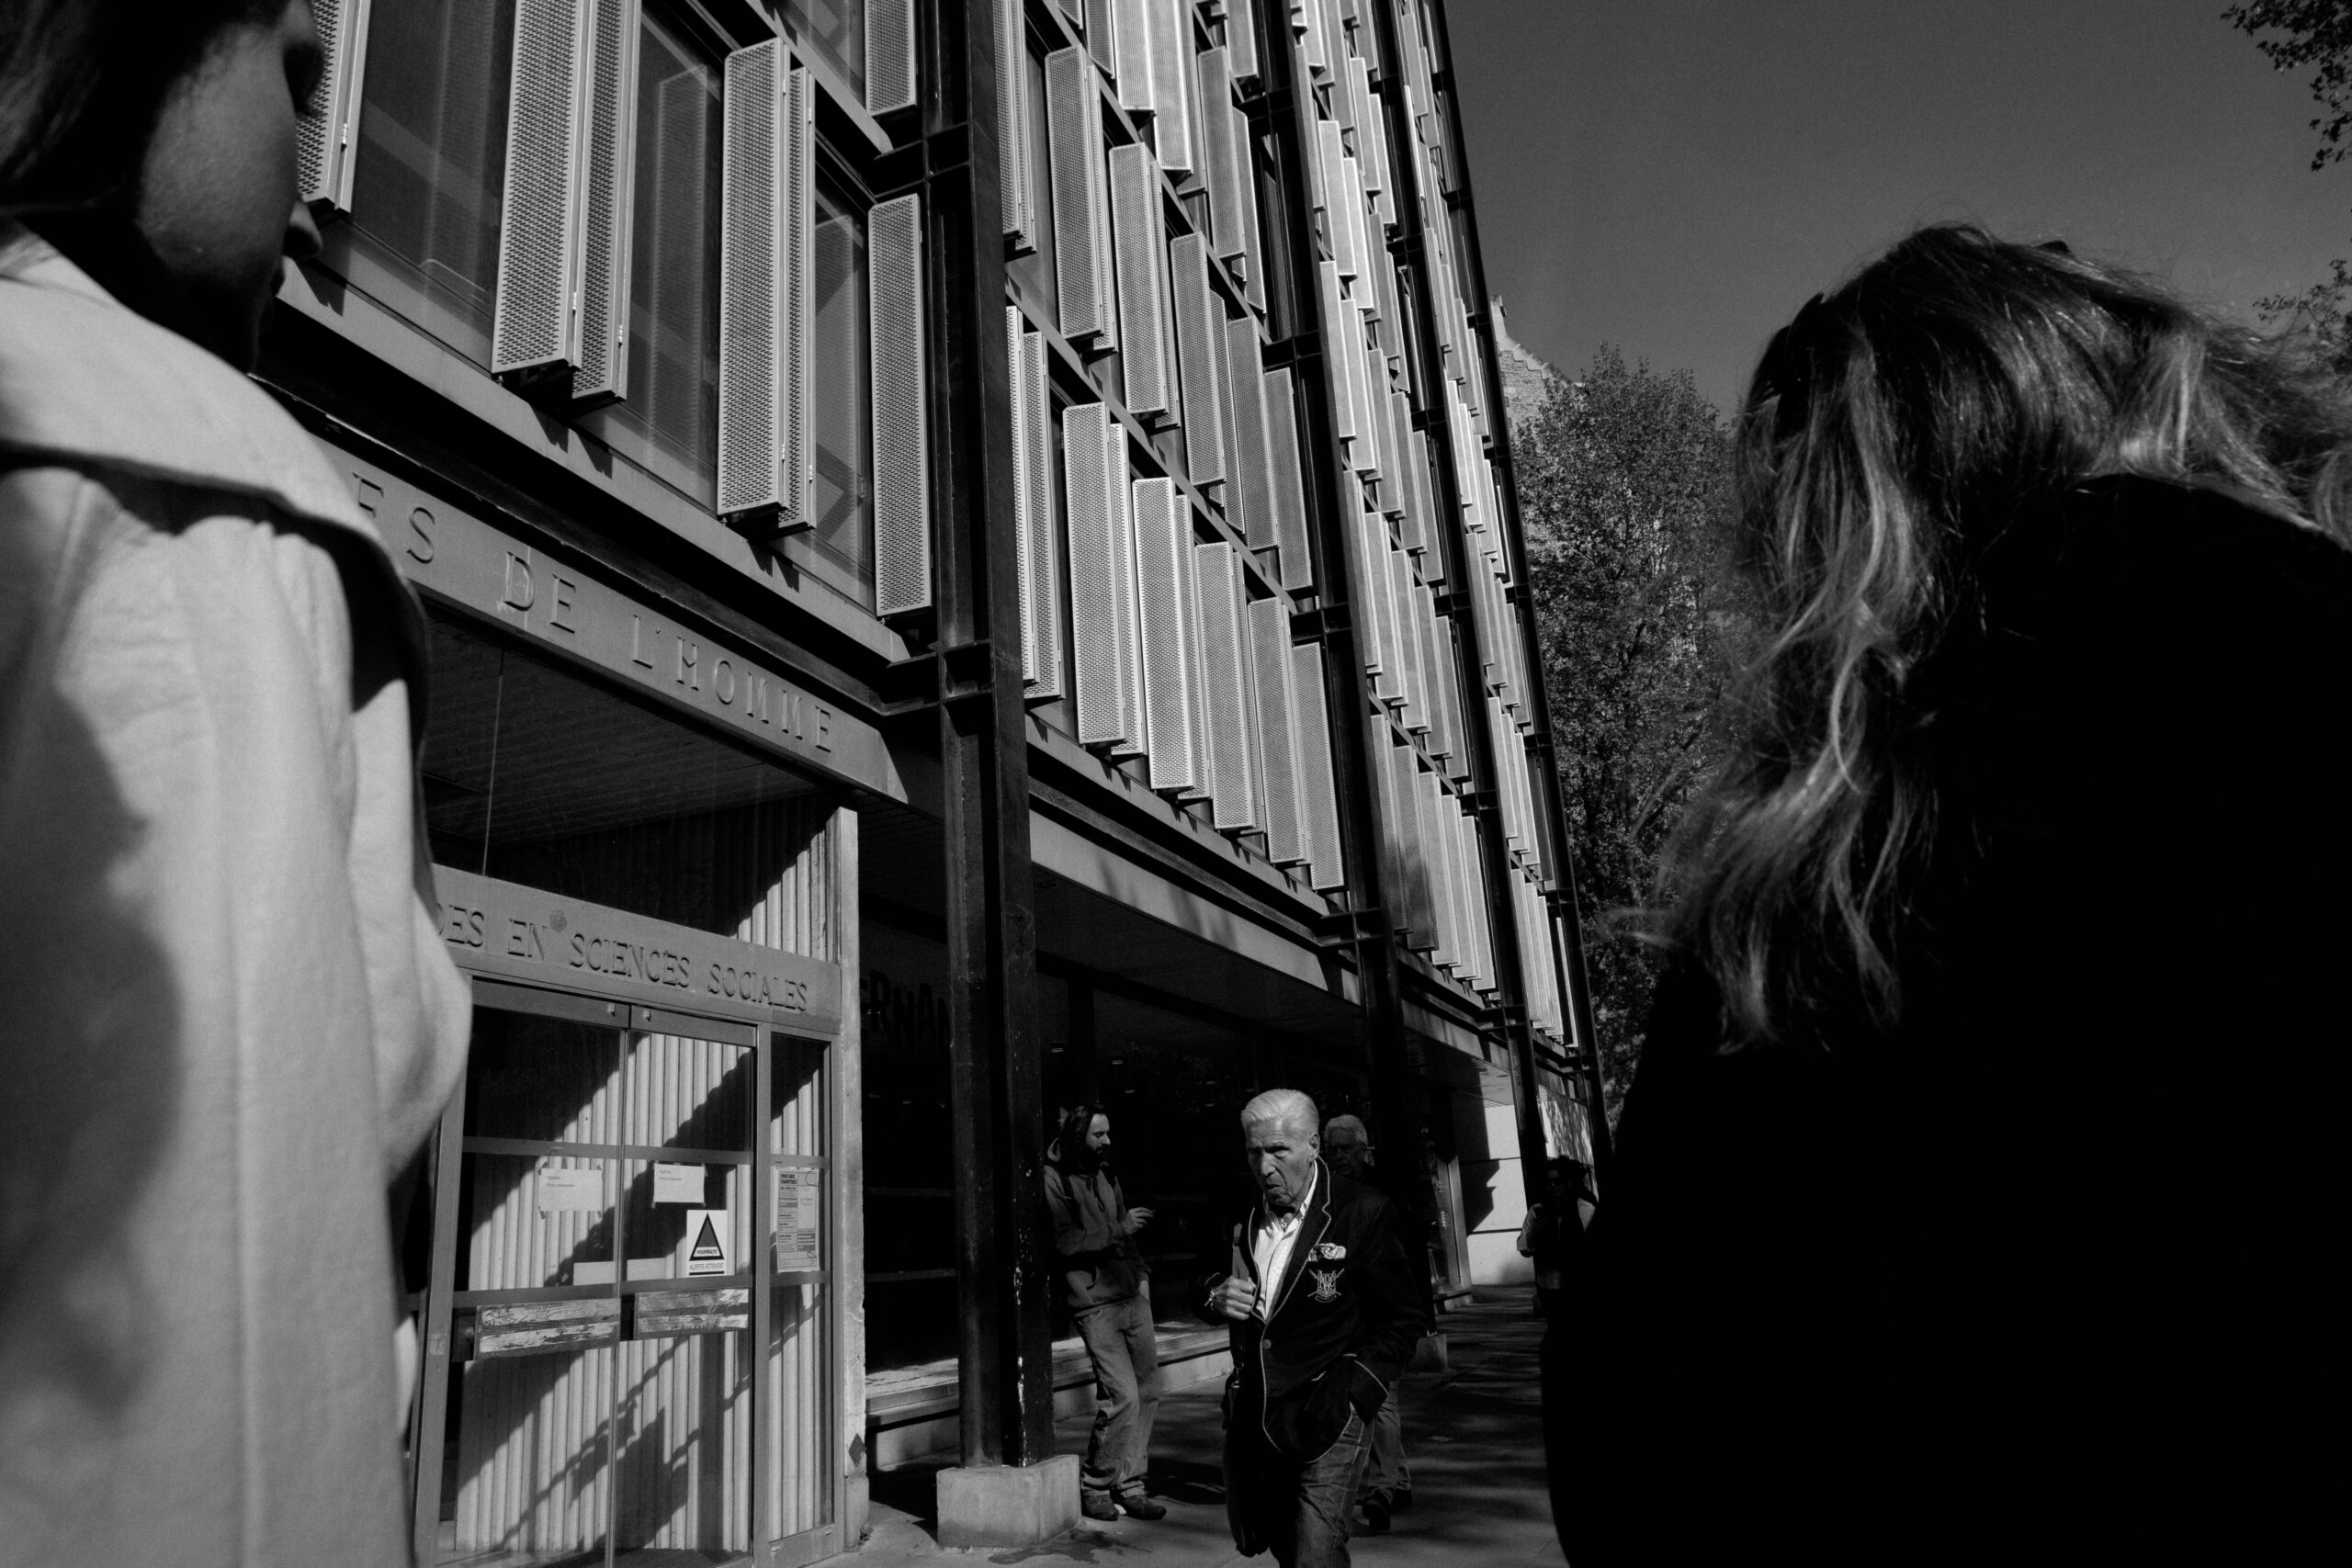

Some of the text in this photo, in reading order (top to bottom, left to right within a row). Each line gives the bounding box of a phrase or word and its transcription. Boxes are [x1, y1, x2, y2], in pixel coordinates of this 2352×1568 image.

[503, 551, 576, 634] DE
[632, 615, 831, 753] L'HOMME
[507, 919, 548, 961] EN
[570, 933, 690, 988] SCIENCES
[708, 964, 808, 1011] SOCIALES
